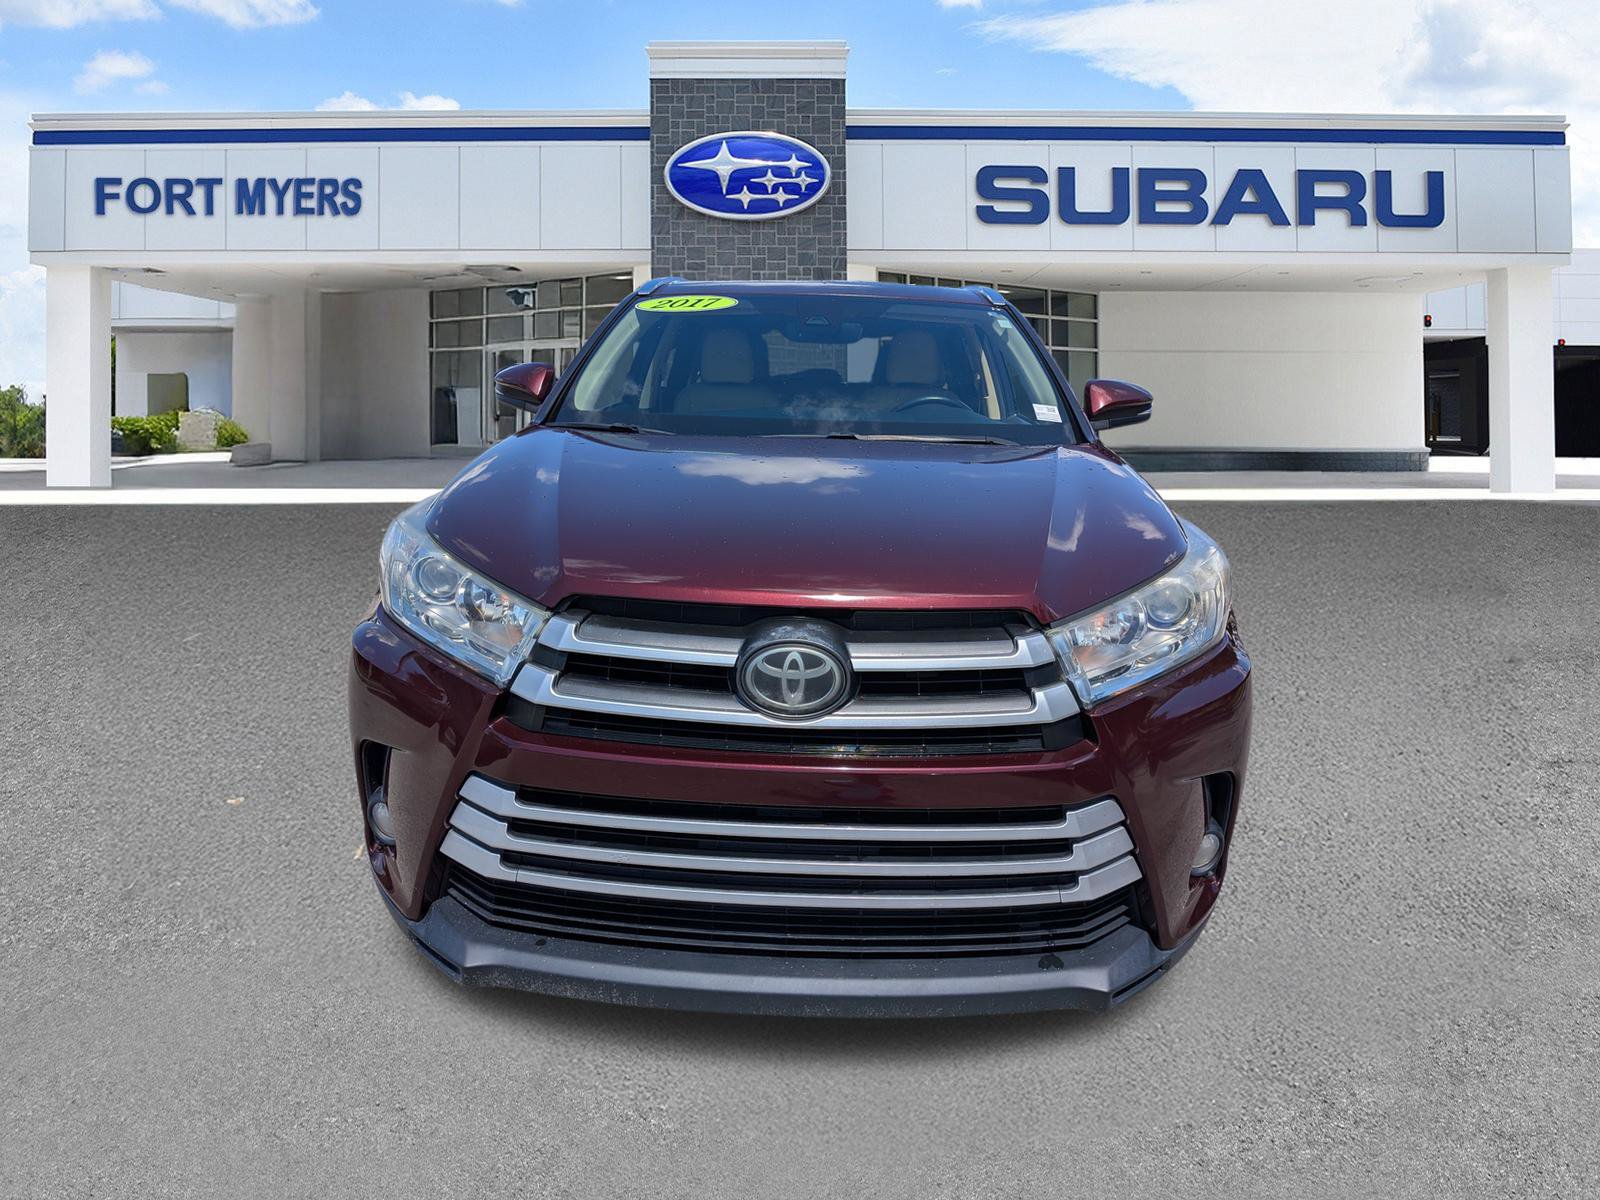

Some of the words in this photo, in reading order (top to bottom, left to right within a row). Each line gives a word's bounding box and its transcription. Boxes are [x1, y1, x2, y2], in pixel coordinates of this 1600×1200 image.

[94, 177, 223, 216] FORT
[235, 177, 363, 216] MYERS
[975, 165, 1446, 228] SUBARU
[650, 298, 722, 309] 2017
